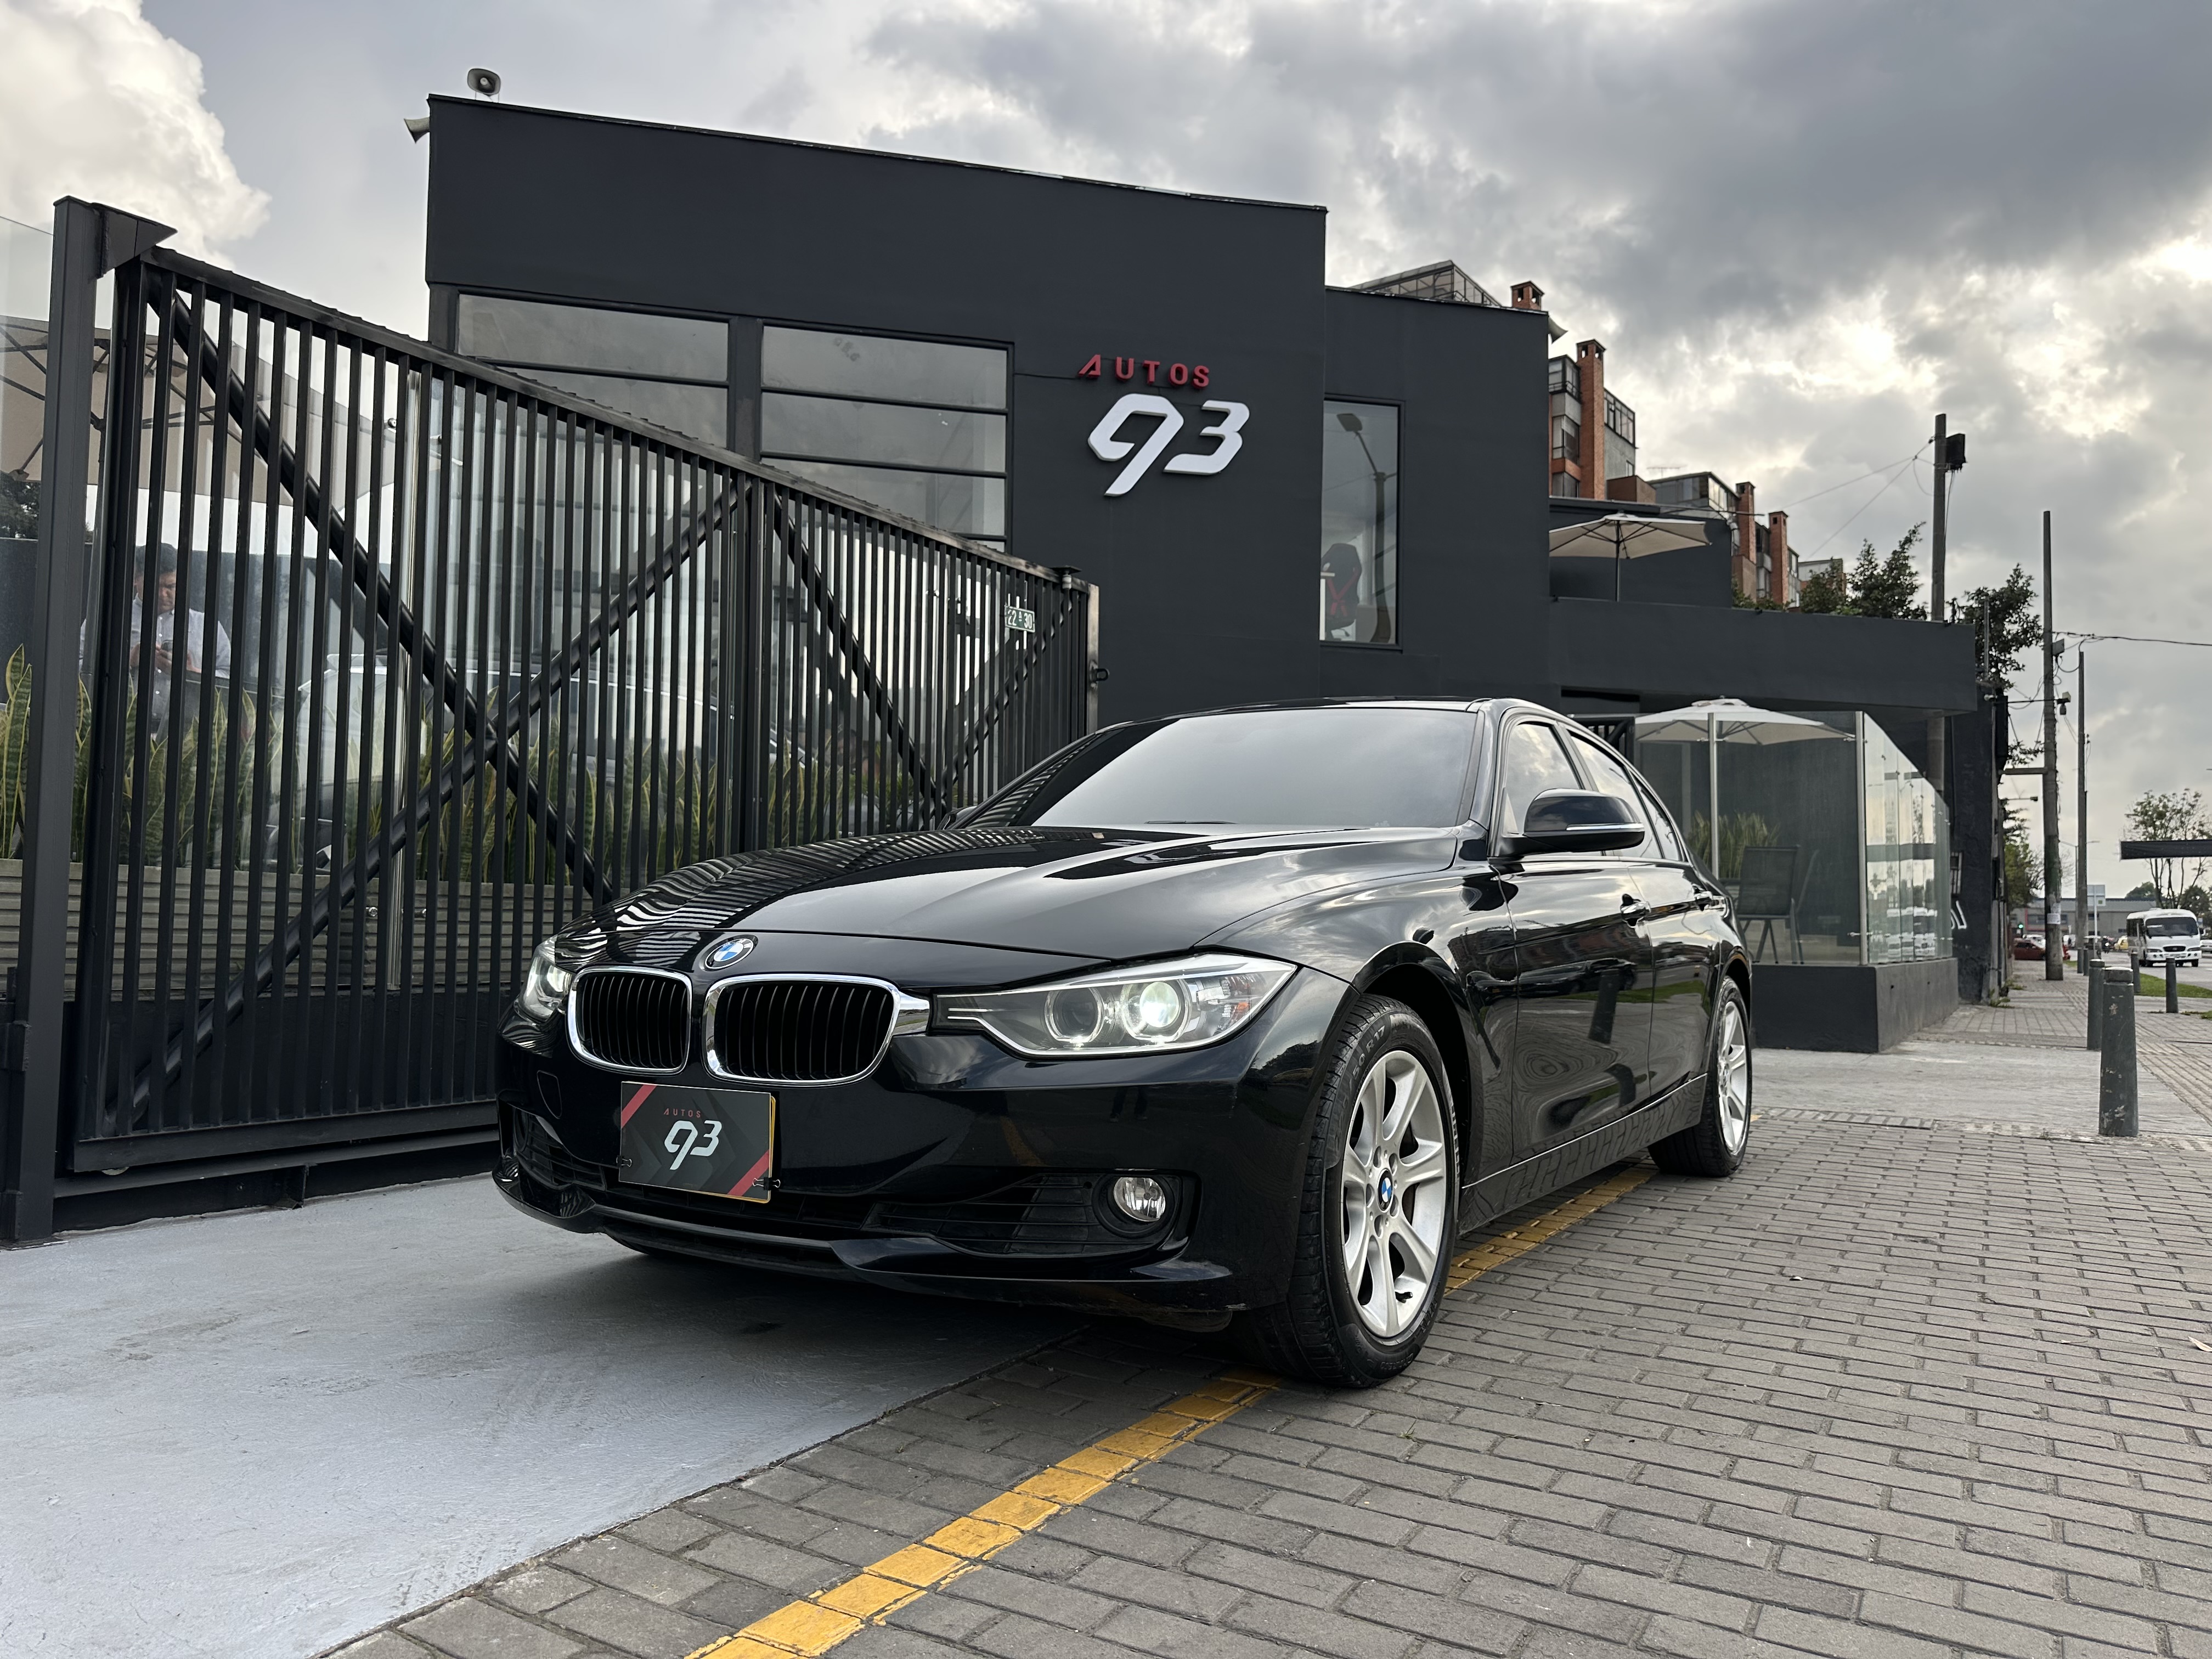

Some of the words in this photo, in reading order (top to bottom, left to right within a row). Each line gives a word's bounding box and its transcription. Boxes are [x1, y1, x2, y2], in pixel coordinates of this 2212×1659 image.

[1077, 354, 1210, 390] AUTOS
[1087, 393, 1250, 497] 93
[663, 1108, 702, 1119] AUTOS
[664, 1119, 723, 1170] 93
